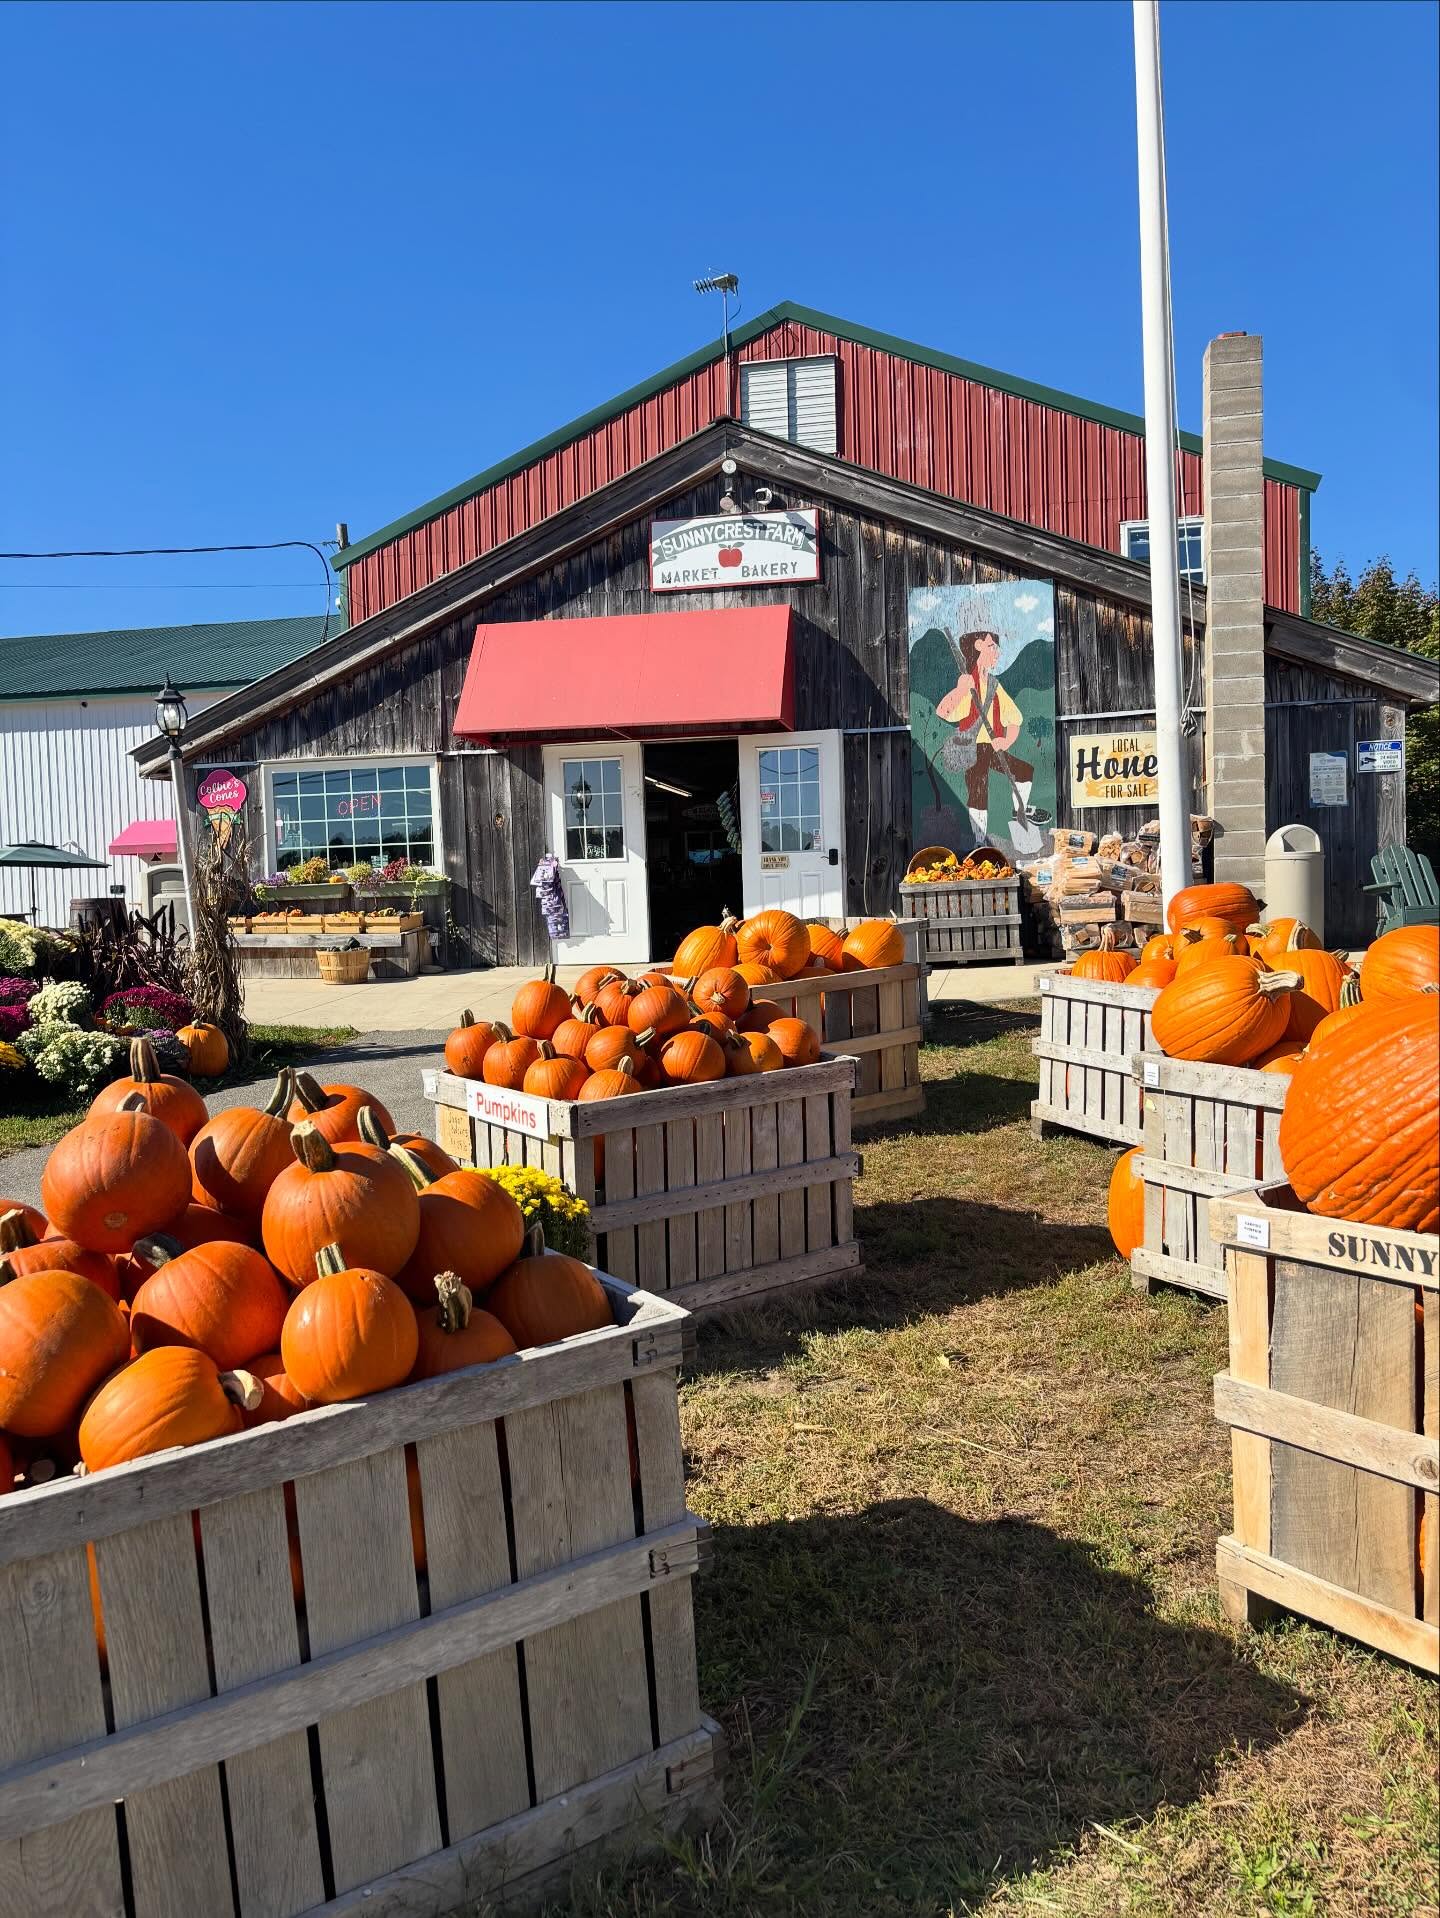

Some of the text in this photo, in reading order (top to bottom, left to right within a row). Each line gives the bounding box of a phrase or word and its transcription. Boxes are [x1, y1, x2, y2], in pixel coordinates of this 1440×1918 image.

[661, 523, 806, 555] SUNNYCREST FARM
[661, 561, 798, 584] MARKET BAKERY
[1112, 738, 1140, 752] LOCAL
[1369, 742, 1392, 751] NOTICE
[1076, 745, 1159, 782] Hone
[209, 790, 239, 804] Cones
[1105, 783, 1149, 798] FOR SALE
[338, 793, 382, 816] OPEN
[476, 1092, 537, 1129] Pumpkins
[1327, 1231, 1438, 1277] SUNNY
